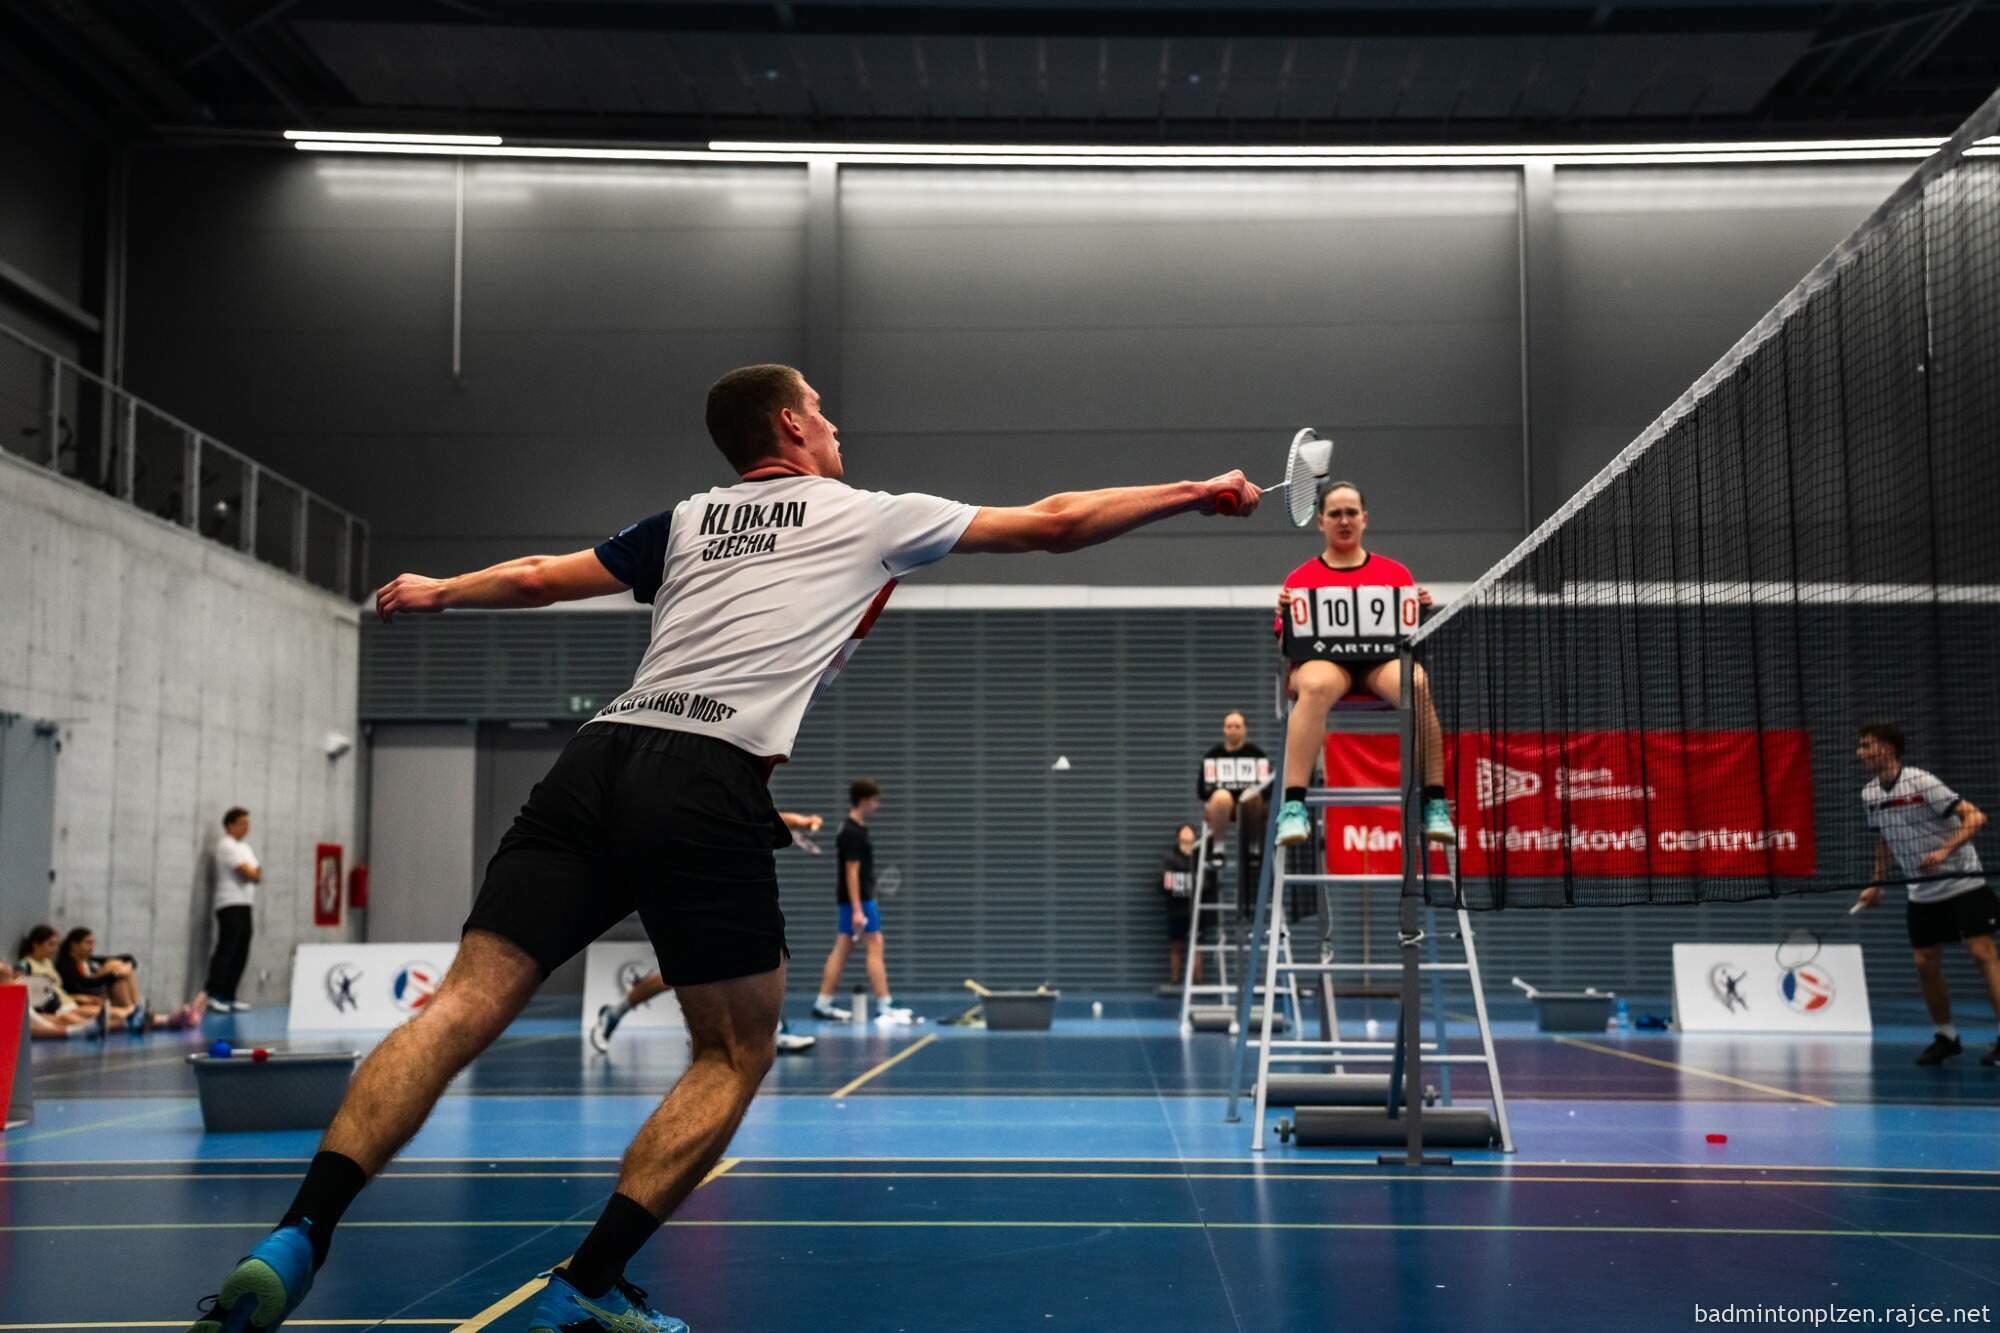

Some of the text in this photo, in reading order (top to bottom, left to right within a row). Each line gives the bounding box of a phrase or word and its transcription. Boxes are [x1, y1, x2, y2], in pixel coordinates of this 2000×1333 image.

[699, 502, 807, 536] KLOKAN
[702, 534, 777, 562] CZECHIA
[1292, 598, 1417, 627] 0 10 9 0
[1330, 643, 1396, 654] ARTIS
[687, 694, 737, 723] MOST
[1343, 825, 1467, 852] Nárí
[1658, 827, 1797, 852] centrum
